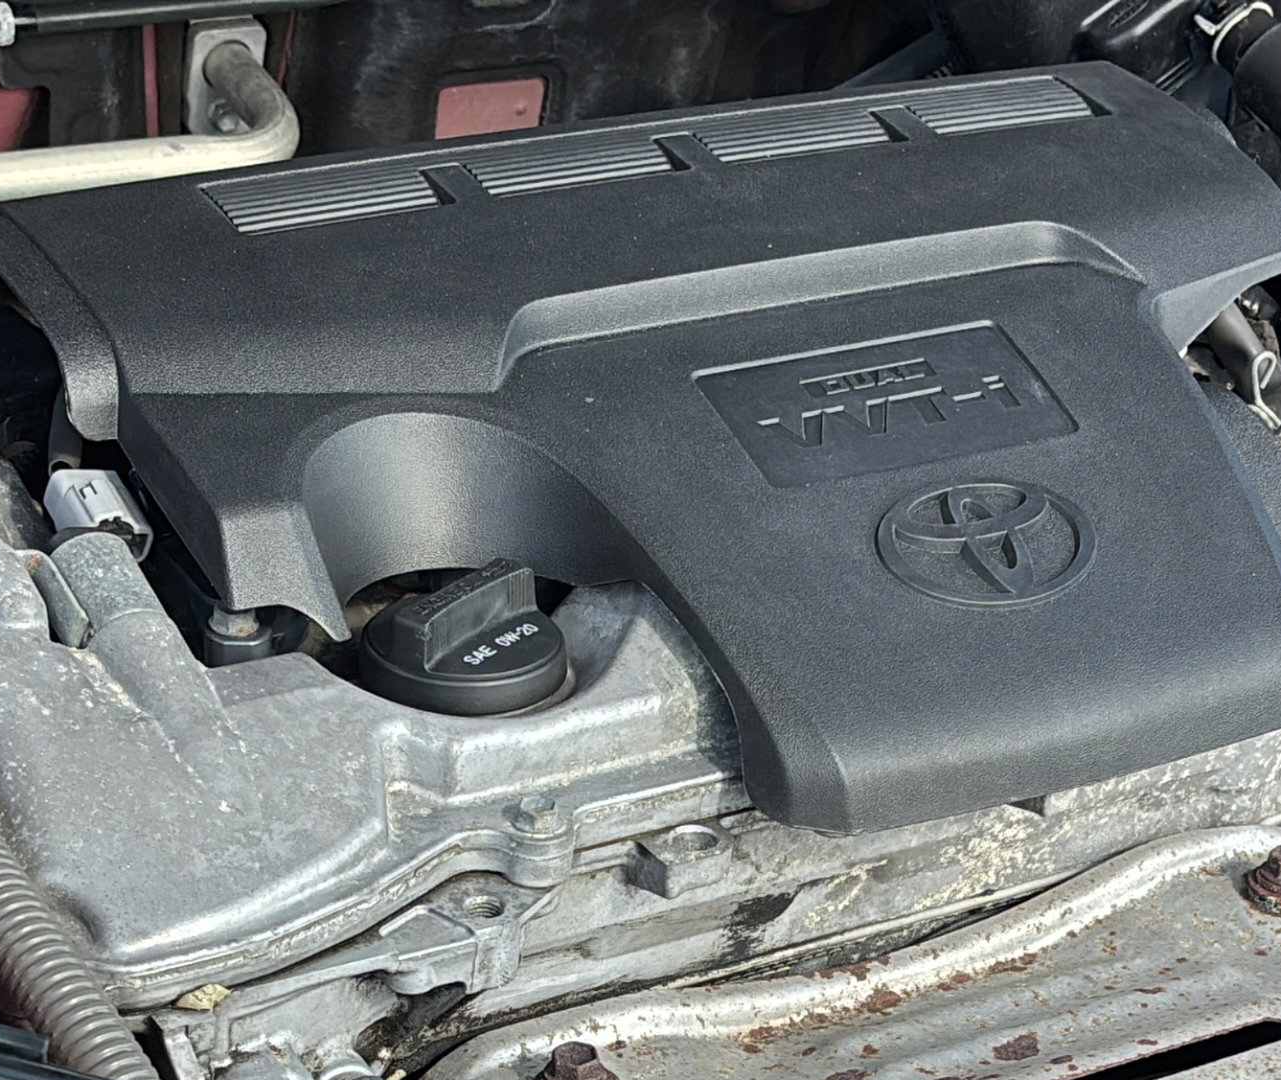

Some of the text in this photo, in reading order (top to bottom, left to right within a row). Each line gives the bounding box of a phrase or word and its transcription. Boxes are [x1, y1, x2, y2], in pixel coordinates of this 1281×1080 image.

[824, 361, 927, 395] DUAL
[463, 623, 539, 666] SAE 0W-20
